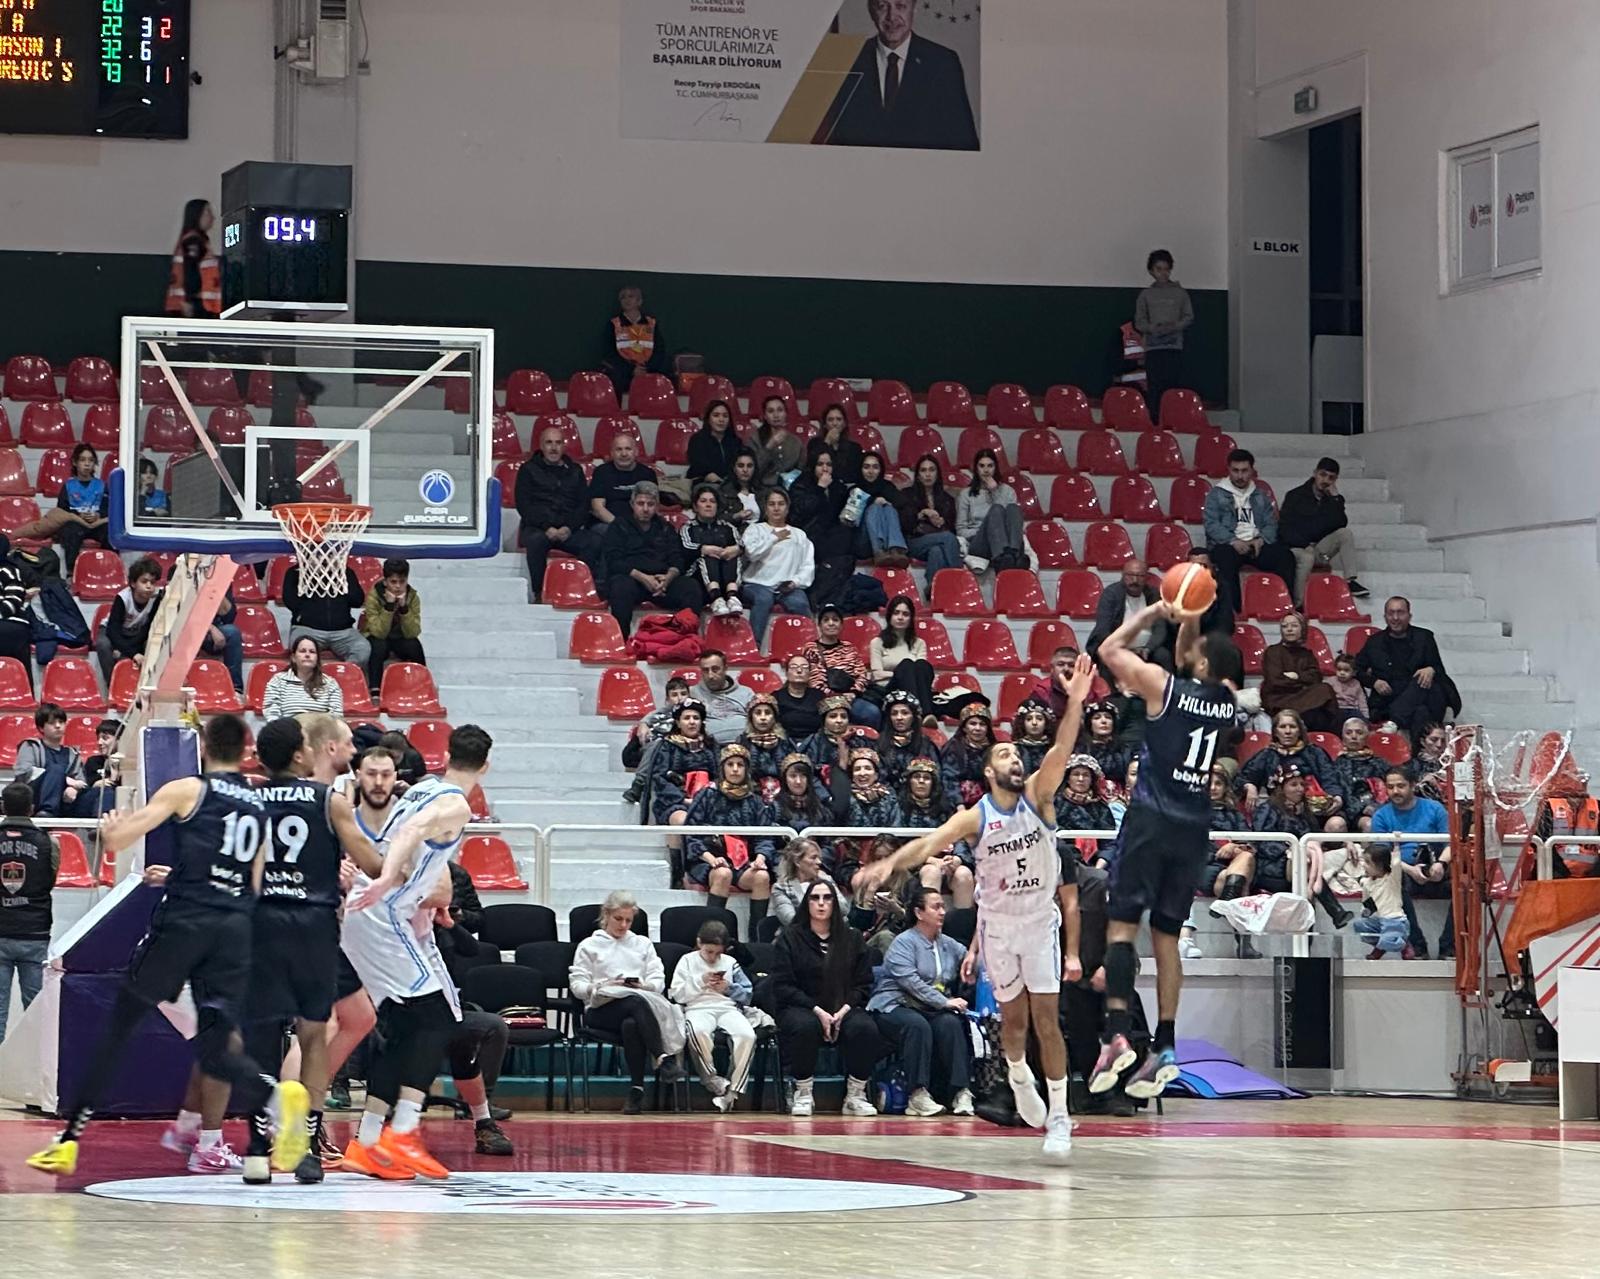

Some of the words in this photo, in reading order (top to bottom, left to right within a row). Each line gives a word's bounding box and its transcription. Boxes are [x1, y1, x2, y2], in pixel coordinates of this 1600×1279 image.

[102, 15, 122, 36] 22
[142, 16, 152, 38] 3
[160, 18, 172, 39] 2
[656, 22, 686, 36] TÜM
[689, 26, 760, 40] ANTRENÖR
[762, 29, 779, 42] VE
[0, 36, 44, 57] ASON
[101, 38, 122, 60] 32
[140, 40, 152, 61] 6
[660, 38, 775, 55] SPORCULARIMIZA
[653, 54, 716, 67] BAŞARILAR
[718, 55, 782, 69] DİLİYORUM
[0, 60, 54, 80] REVIC
[61, 62, 73, 82] S
[674, 80, 696, 88] Recep
[698, 80, 722, 89] Tayyip
[723, 80, 760, 90] ERDOĞAN
[264, 216, 316, 242] 09.4
[1254, 241, 1262, 251] L
[1263, 241, 1300, 254] BLOK
[404, 514, 446, 523] EUROPE
[447, 516, 468, 524] CUP
[560, 562, 575, 571] 13
[587, 615, 602, 624] 13
[786, 618, 801, 627] 10
[1047, 624, 1055, 632] 6
[1237, 626, 1244, 634] 3
[66, 661, 75, 669] 6
[614, 672, 629, 680] 13
[683, 672, 697, 680] 12
[752, 673, 765, 681] 11
[1178, 694, 1234, 719] HILLIARD
[15, 717, 24, 725] 7
[82, 717, 92, 725] 6
[1184, 726, 1218, 772] 11
[219, 811, 260, 863] 10
[482, 838, 490, 846] 1
[1024, 826, 1042, 848] SPO
[15, 840, 38, 860] ŞUBE
[1016, 858, 1026, 876] 5
